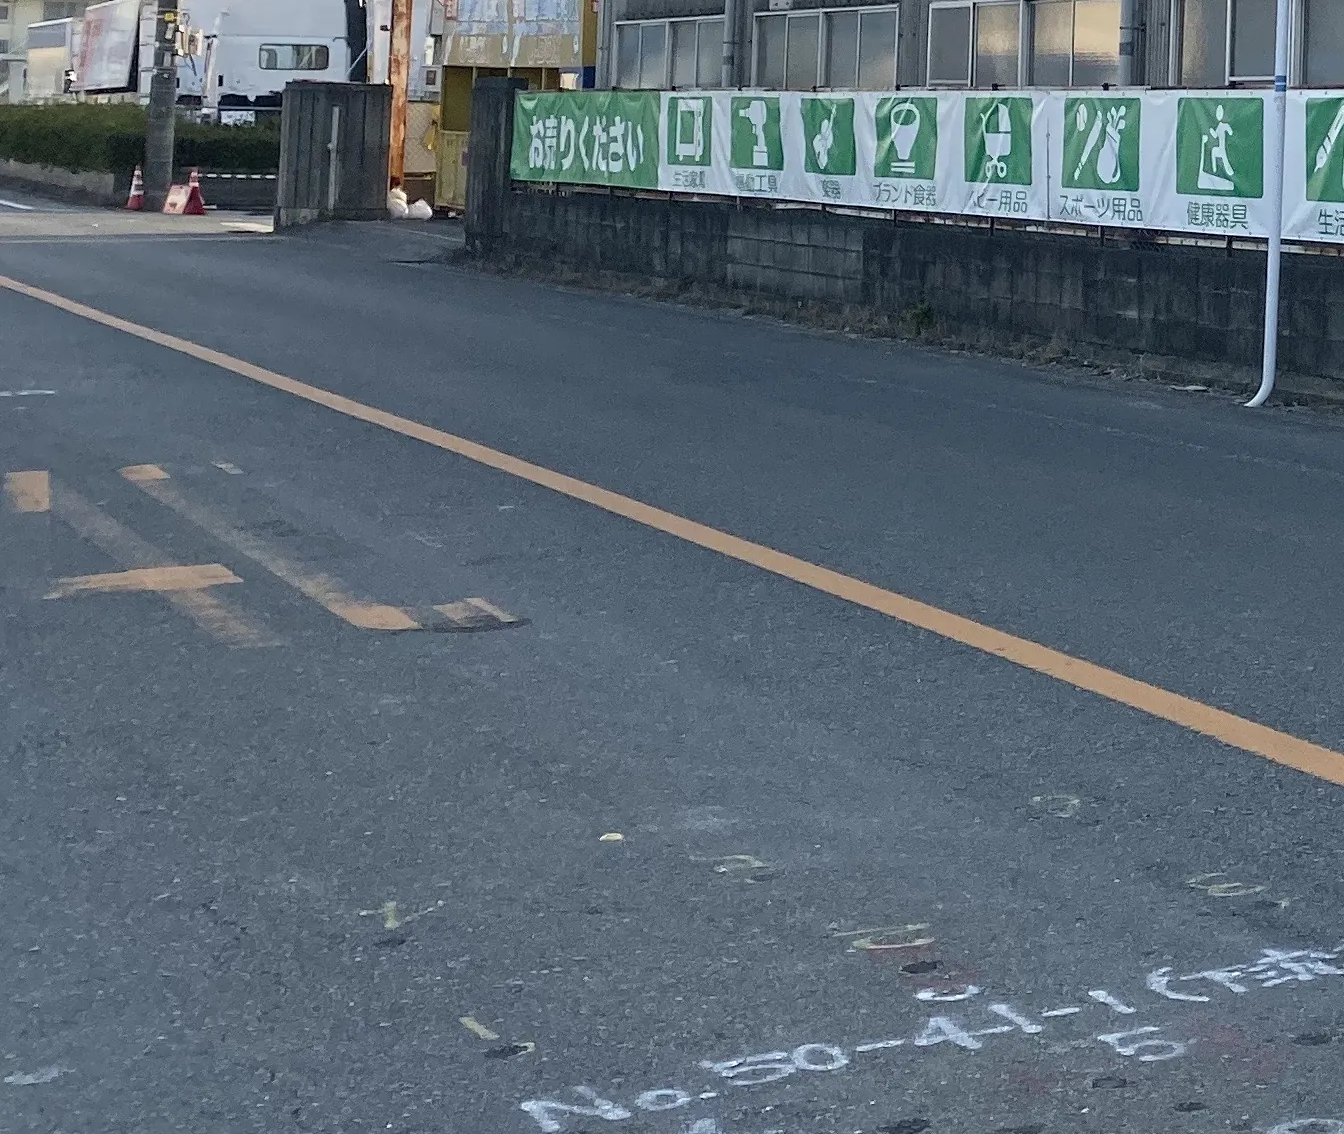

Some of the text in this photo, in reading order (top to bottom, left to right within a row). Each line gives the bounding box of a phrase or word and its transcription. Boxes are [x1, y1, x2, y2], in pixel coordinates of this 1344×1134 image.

[528, 115, 644, 175] お売りください
[873, 183, 937, 207] ブランド食器
[1059, 194, 1144, 222] スポーツ用品
[1186, 201, 1249, 230] 健康器具
